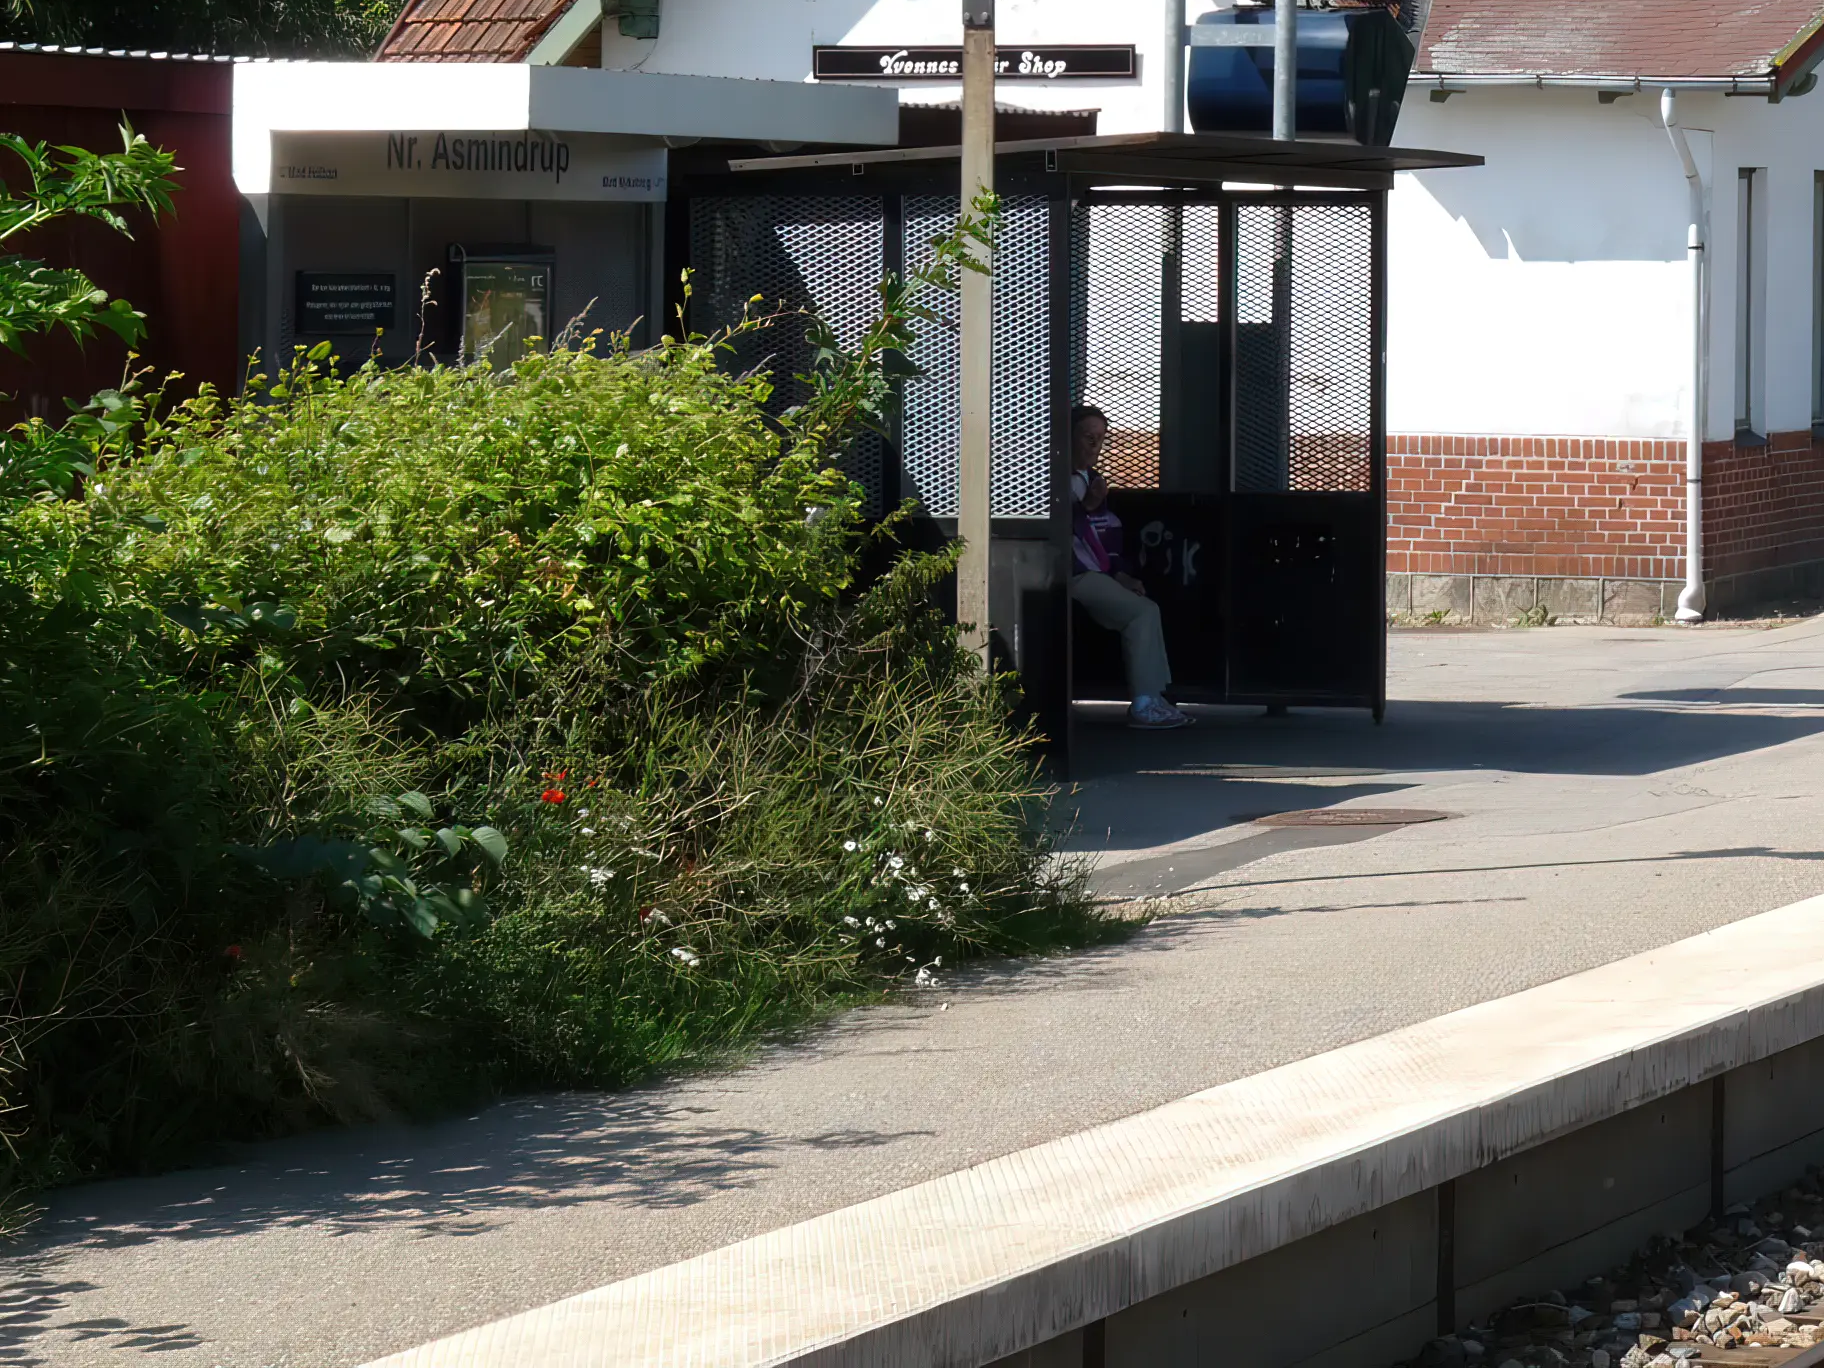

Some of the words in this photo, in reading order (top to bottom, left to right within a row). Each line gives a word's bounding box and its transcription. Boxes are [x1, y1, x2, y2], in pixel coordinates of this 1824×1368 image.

[879, 49, 959, 74] Yvonnes
[1018, 51, 1067, 78] Shop
[387, 131, 422, 169] Nr.
[431, 130, 570, 184] Asmindrup
